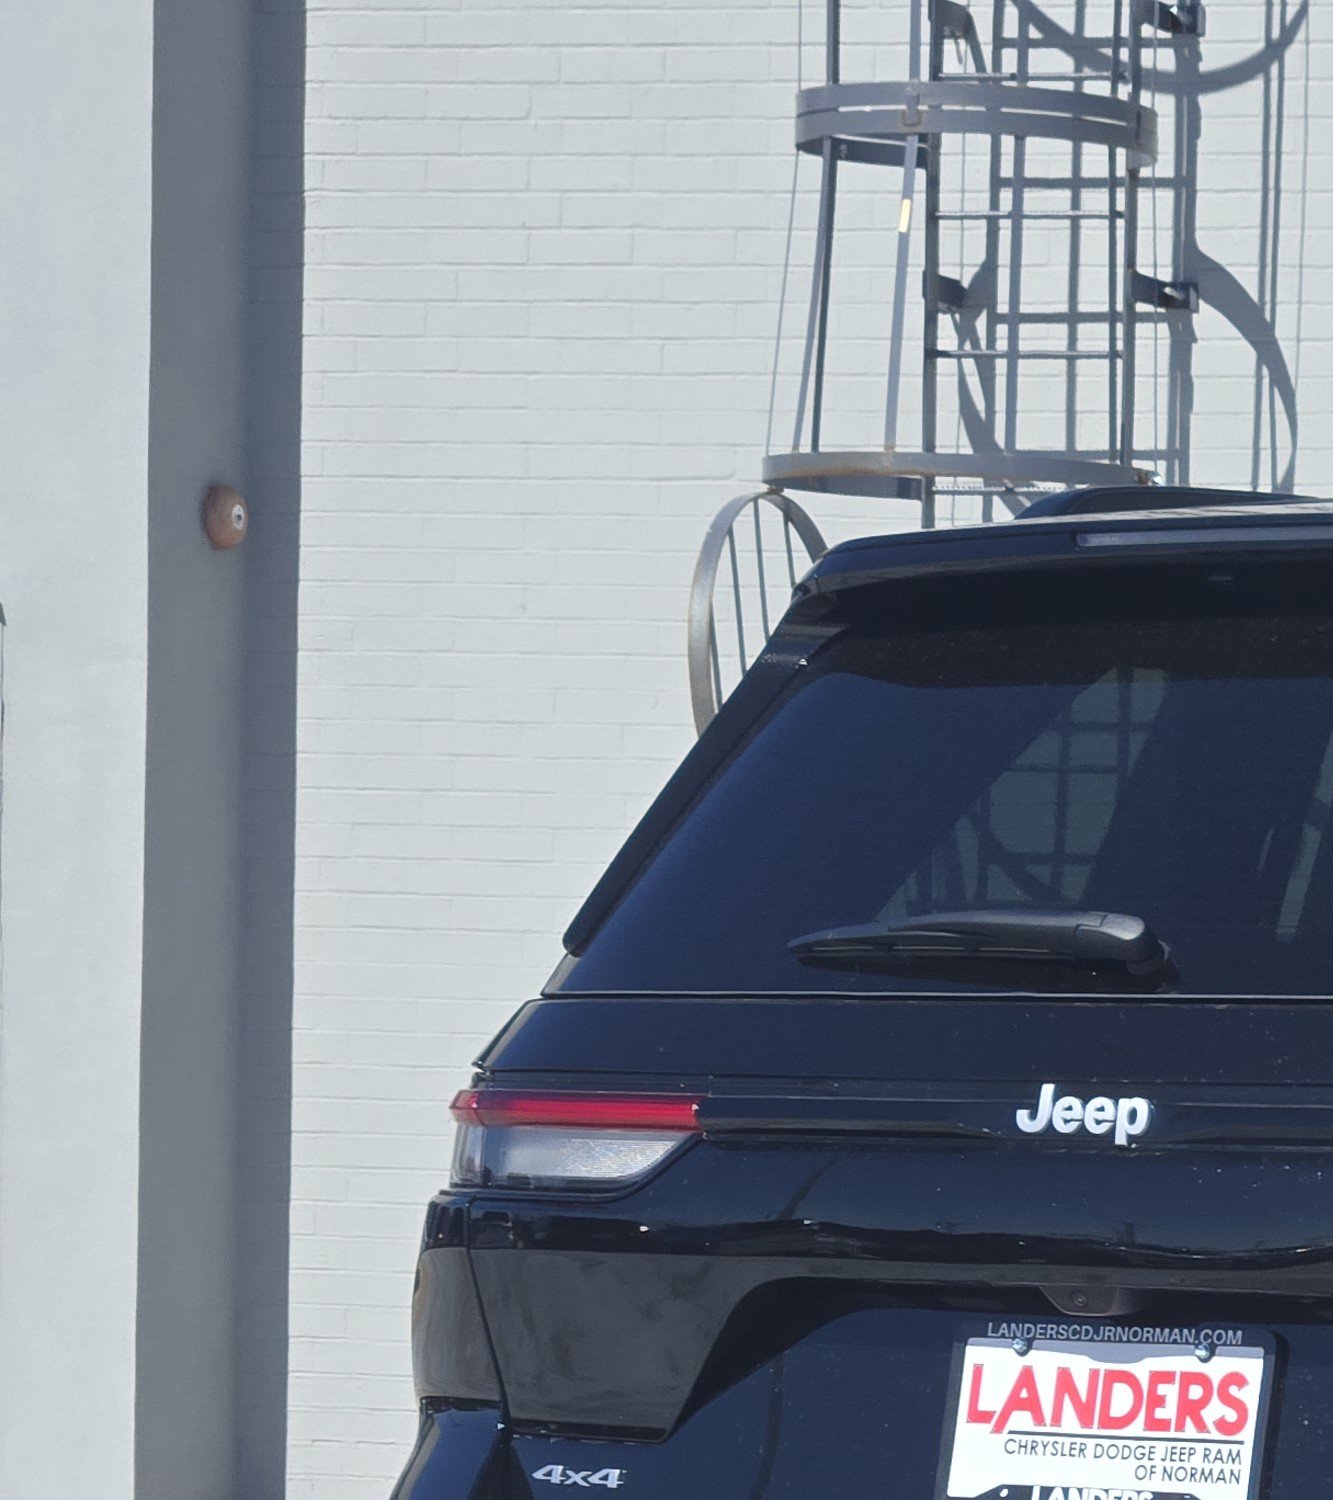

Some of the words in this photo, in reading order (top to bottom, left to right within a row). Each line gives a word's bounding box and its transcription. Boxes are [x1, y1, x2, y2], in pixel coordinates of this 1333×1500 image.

[1016, 1083, 1150, 1145] Jeep
[987, 1322, 1243, 1346] LANDERSCDJRNORMAN.COM
[966, 1363, 1249, 1436] LANDERS
[1004, 1438, 1087, 1459] CHRYSLER
[1093, 1443, 1155, 1462] DODGE
[1160, 1446, 1196, 1464] JEEP
[1202, 1448, 1242, 1465] RAM
[532, 1464, 624, 1488] 4x4
[1134, 1464, 1157, 1481] OF
[1160, 1466, 1241, 1485] NORMAN
